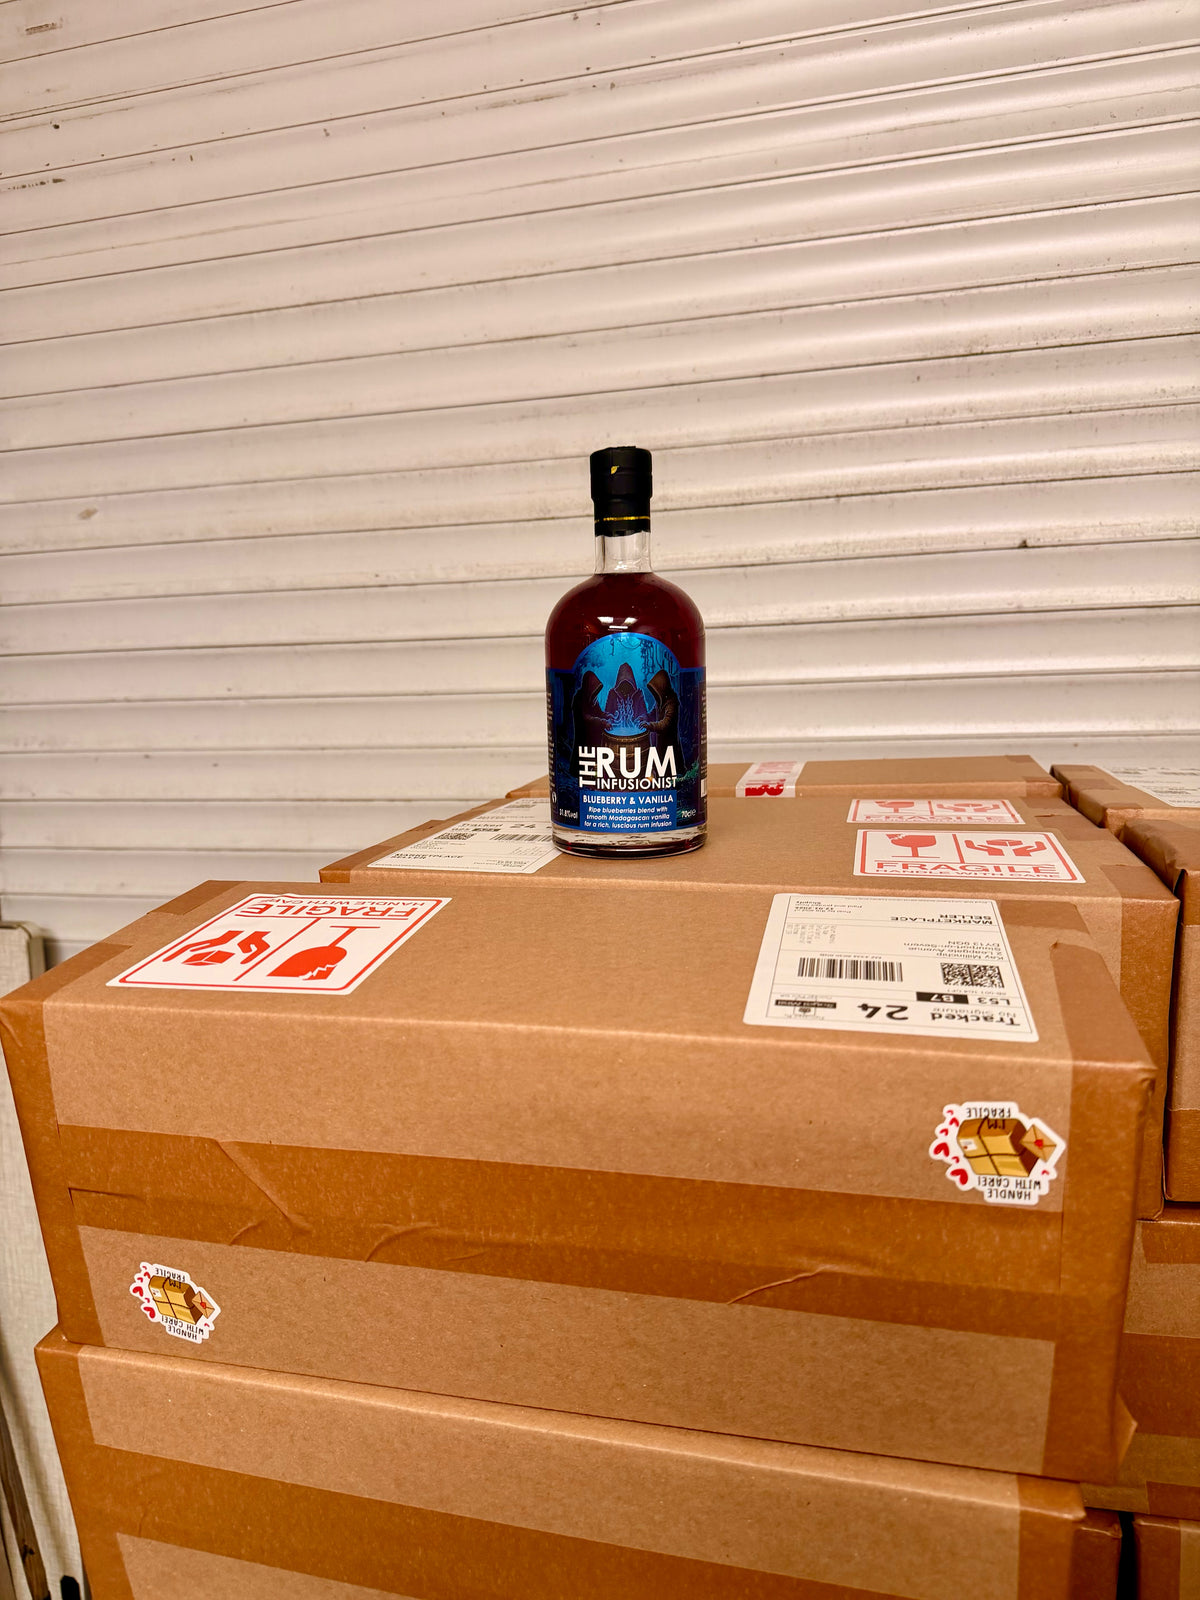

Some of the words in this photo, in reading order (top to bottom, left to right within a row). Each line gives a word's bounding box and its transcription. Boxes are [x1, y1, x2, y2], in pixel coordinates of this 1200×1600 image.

[579, 746, 596, 788] THE
[597, 746, 677, 779] RUM
[597, 776, 677, 790] INFUSIONIST
[583, 795, 626, 805] BLUEBERRY
[629, 796, 636, 805] &
[638, 795, 674, 804] VANILLA
[588, 806, 600, 814] Ripe
[602, 806, 636, 814] blueberries
[637, 806, 656, 814] blend
[586, 813, 608, 821] smooth
[608, 814, 650, 822] Madagascan
[650, 813, 670, 821] vanilla
[611, 821, 637, 829] luscious
[650, 820, 672, 828] infusion
[876, 862, 1060, 874] FRAGILE
[240, 903, 418, 918] FRAGILE
[891, 916, 993, 925] MARKETPLACE
[929, 994, 955, 1002] B7
[977, 997, 1011, 1005] L53
[856, 1003, 910, 1021] 24
[930, 1013, 1020, 1026] Tracked
[965, 1107, 1011, 1118] FRAGILE
[987, 1118, 1006, 1130] I'M
[977, 1176, 1010, 1188] CARE!
[1014, 1178, 1041, 1190] WITH
[986, 1188, 1031, 1201] HANDLE
[155, 1267, 186, 1283] FRAGILE
[168, 1280, 182, 1290] I'M
[161, 1315, 184, 1328] CARE!
[167, 1324, 197, 1341] HANDLE
[186, 1323, 204, 1336] WITH
